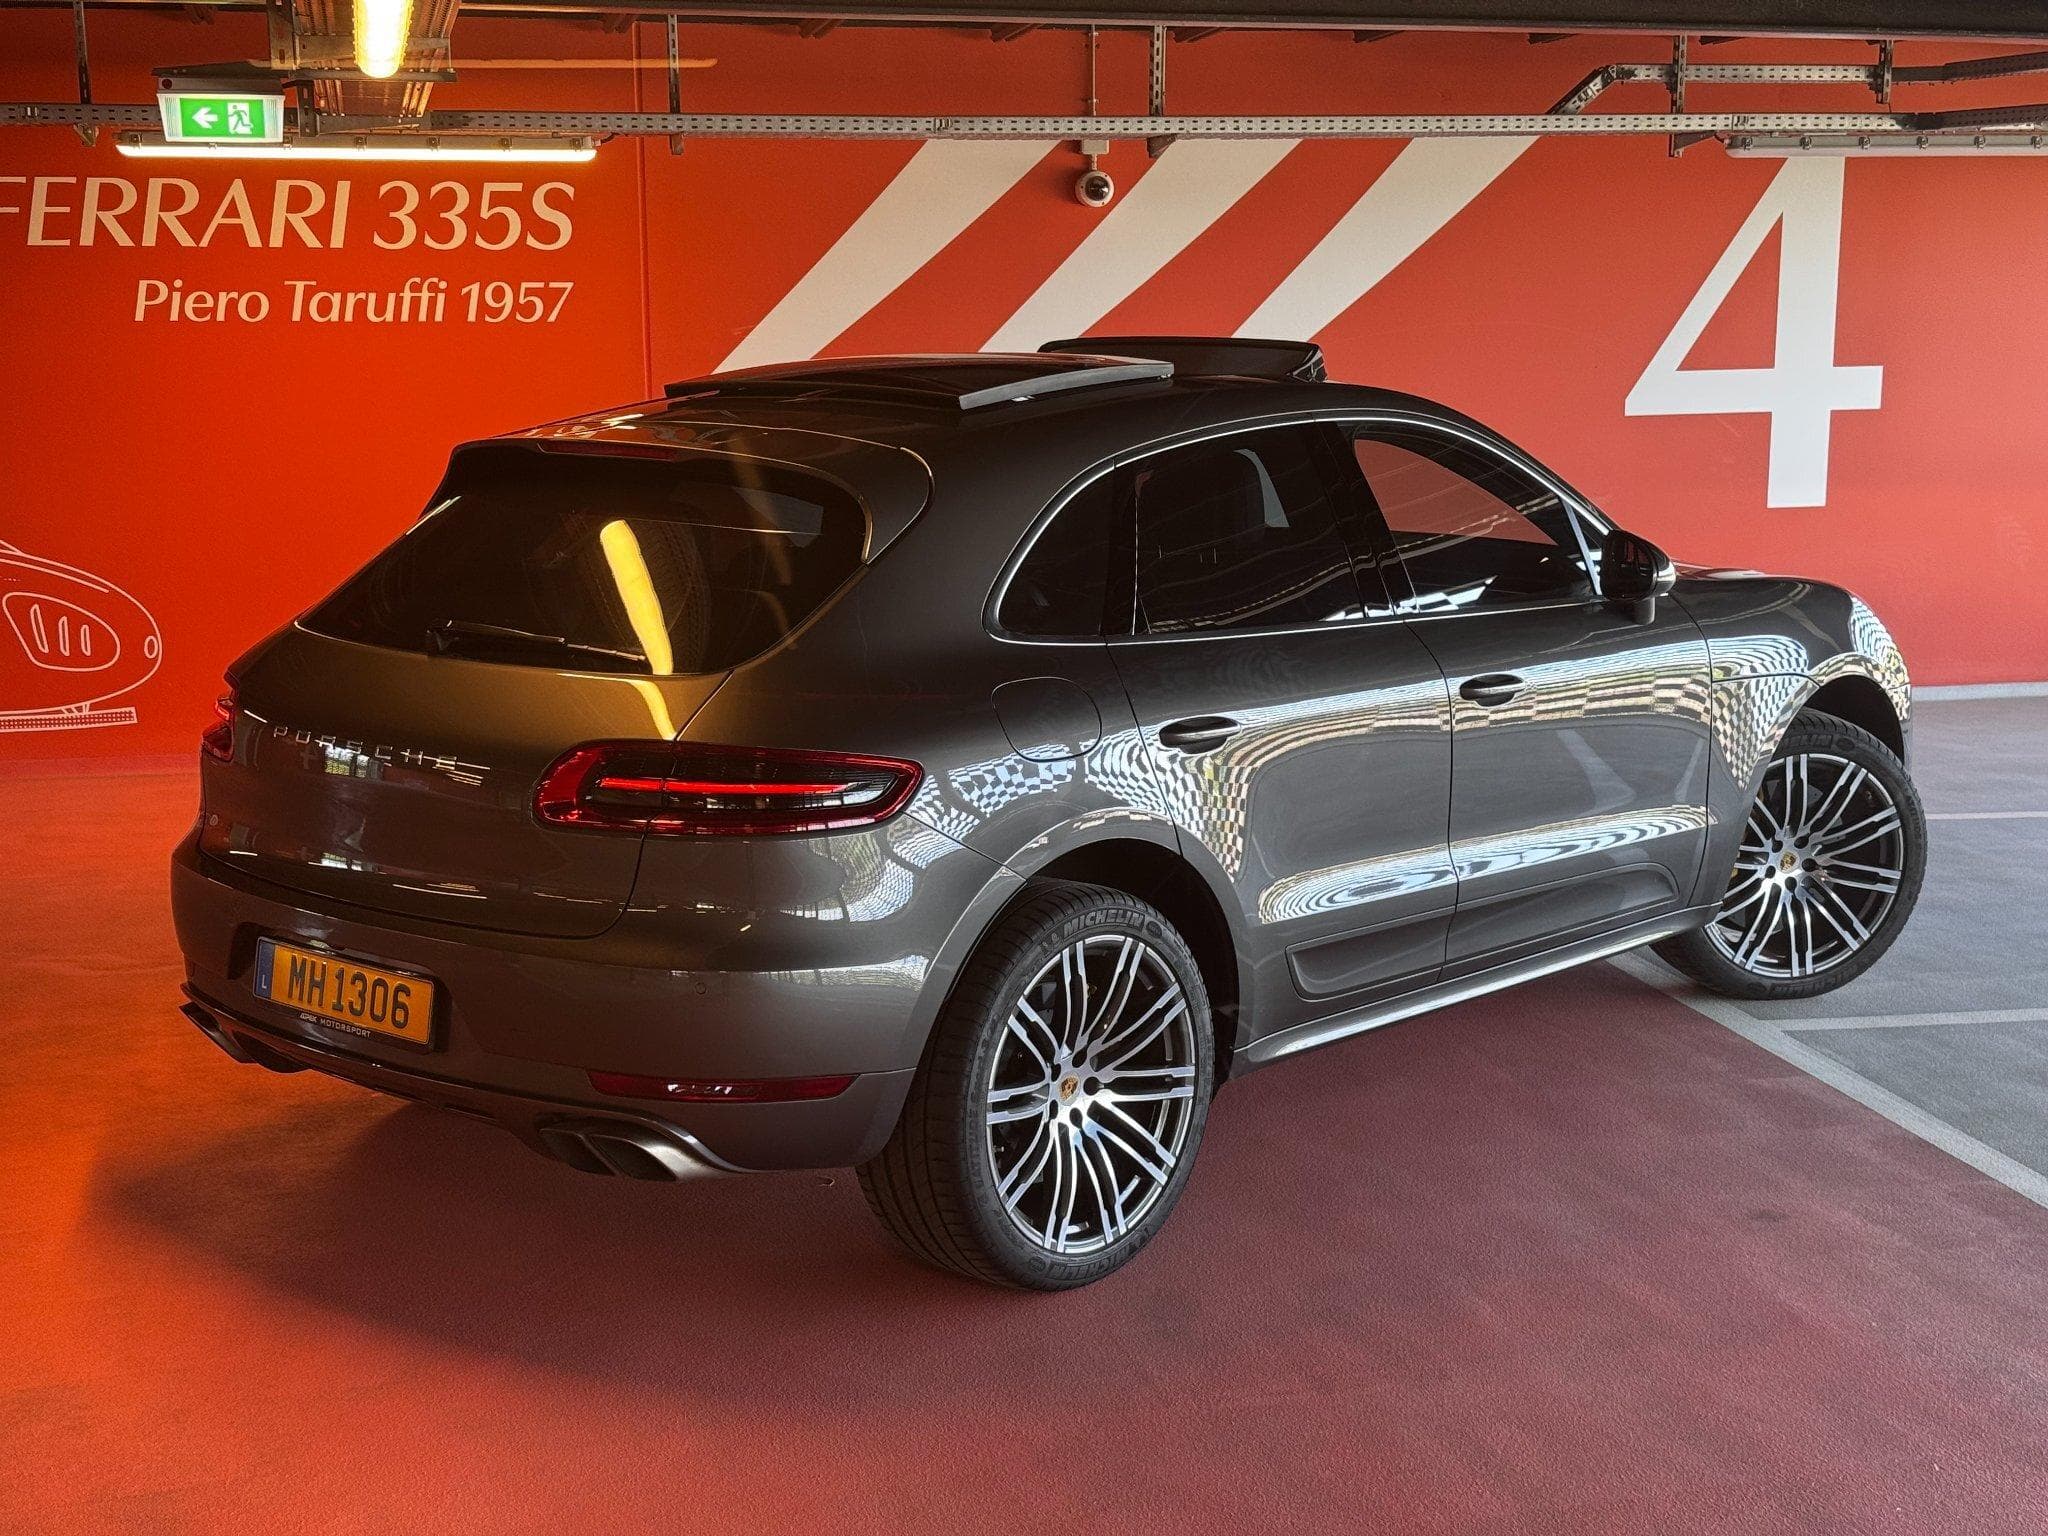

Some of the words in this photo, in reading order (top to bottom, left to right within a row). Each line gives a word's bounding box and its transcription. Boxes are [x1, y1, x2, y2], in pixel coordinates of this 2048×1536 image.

[373, 180, 575, 251] 335S
[134, 279, 270, 322] Piero
[284, 277, 447, 323] Taruffi
[460, 281, 574, 323] 1957
[1624, 156, 1884, 508] 4
[1063, 909, 1145, 938] MICHELIN
[320, 1018, 371, 1037] MOTORSPORT
